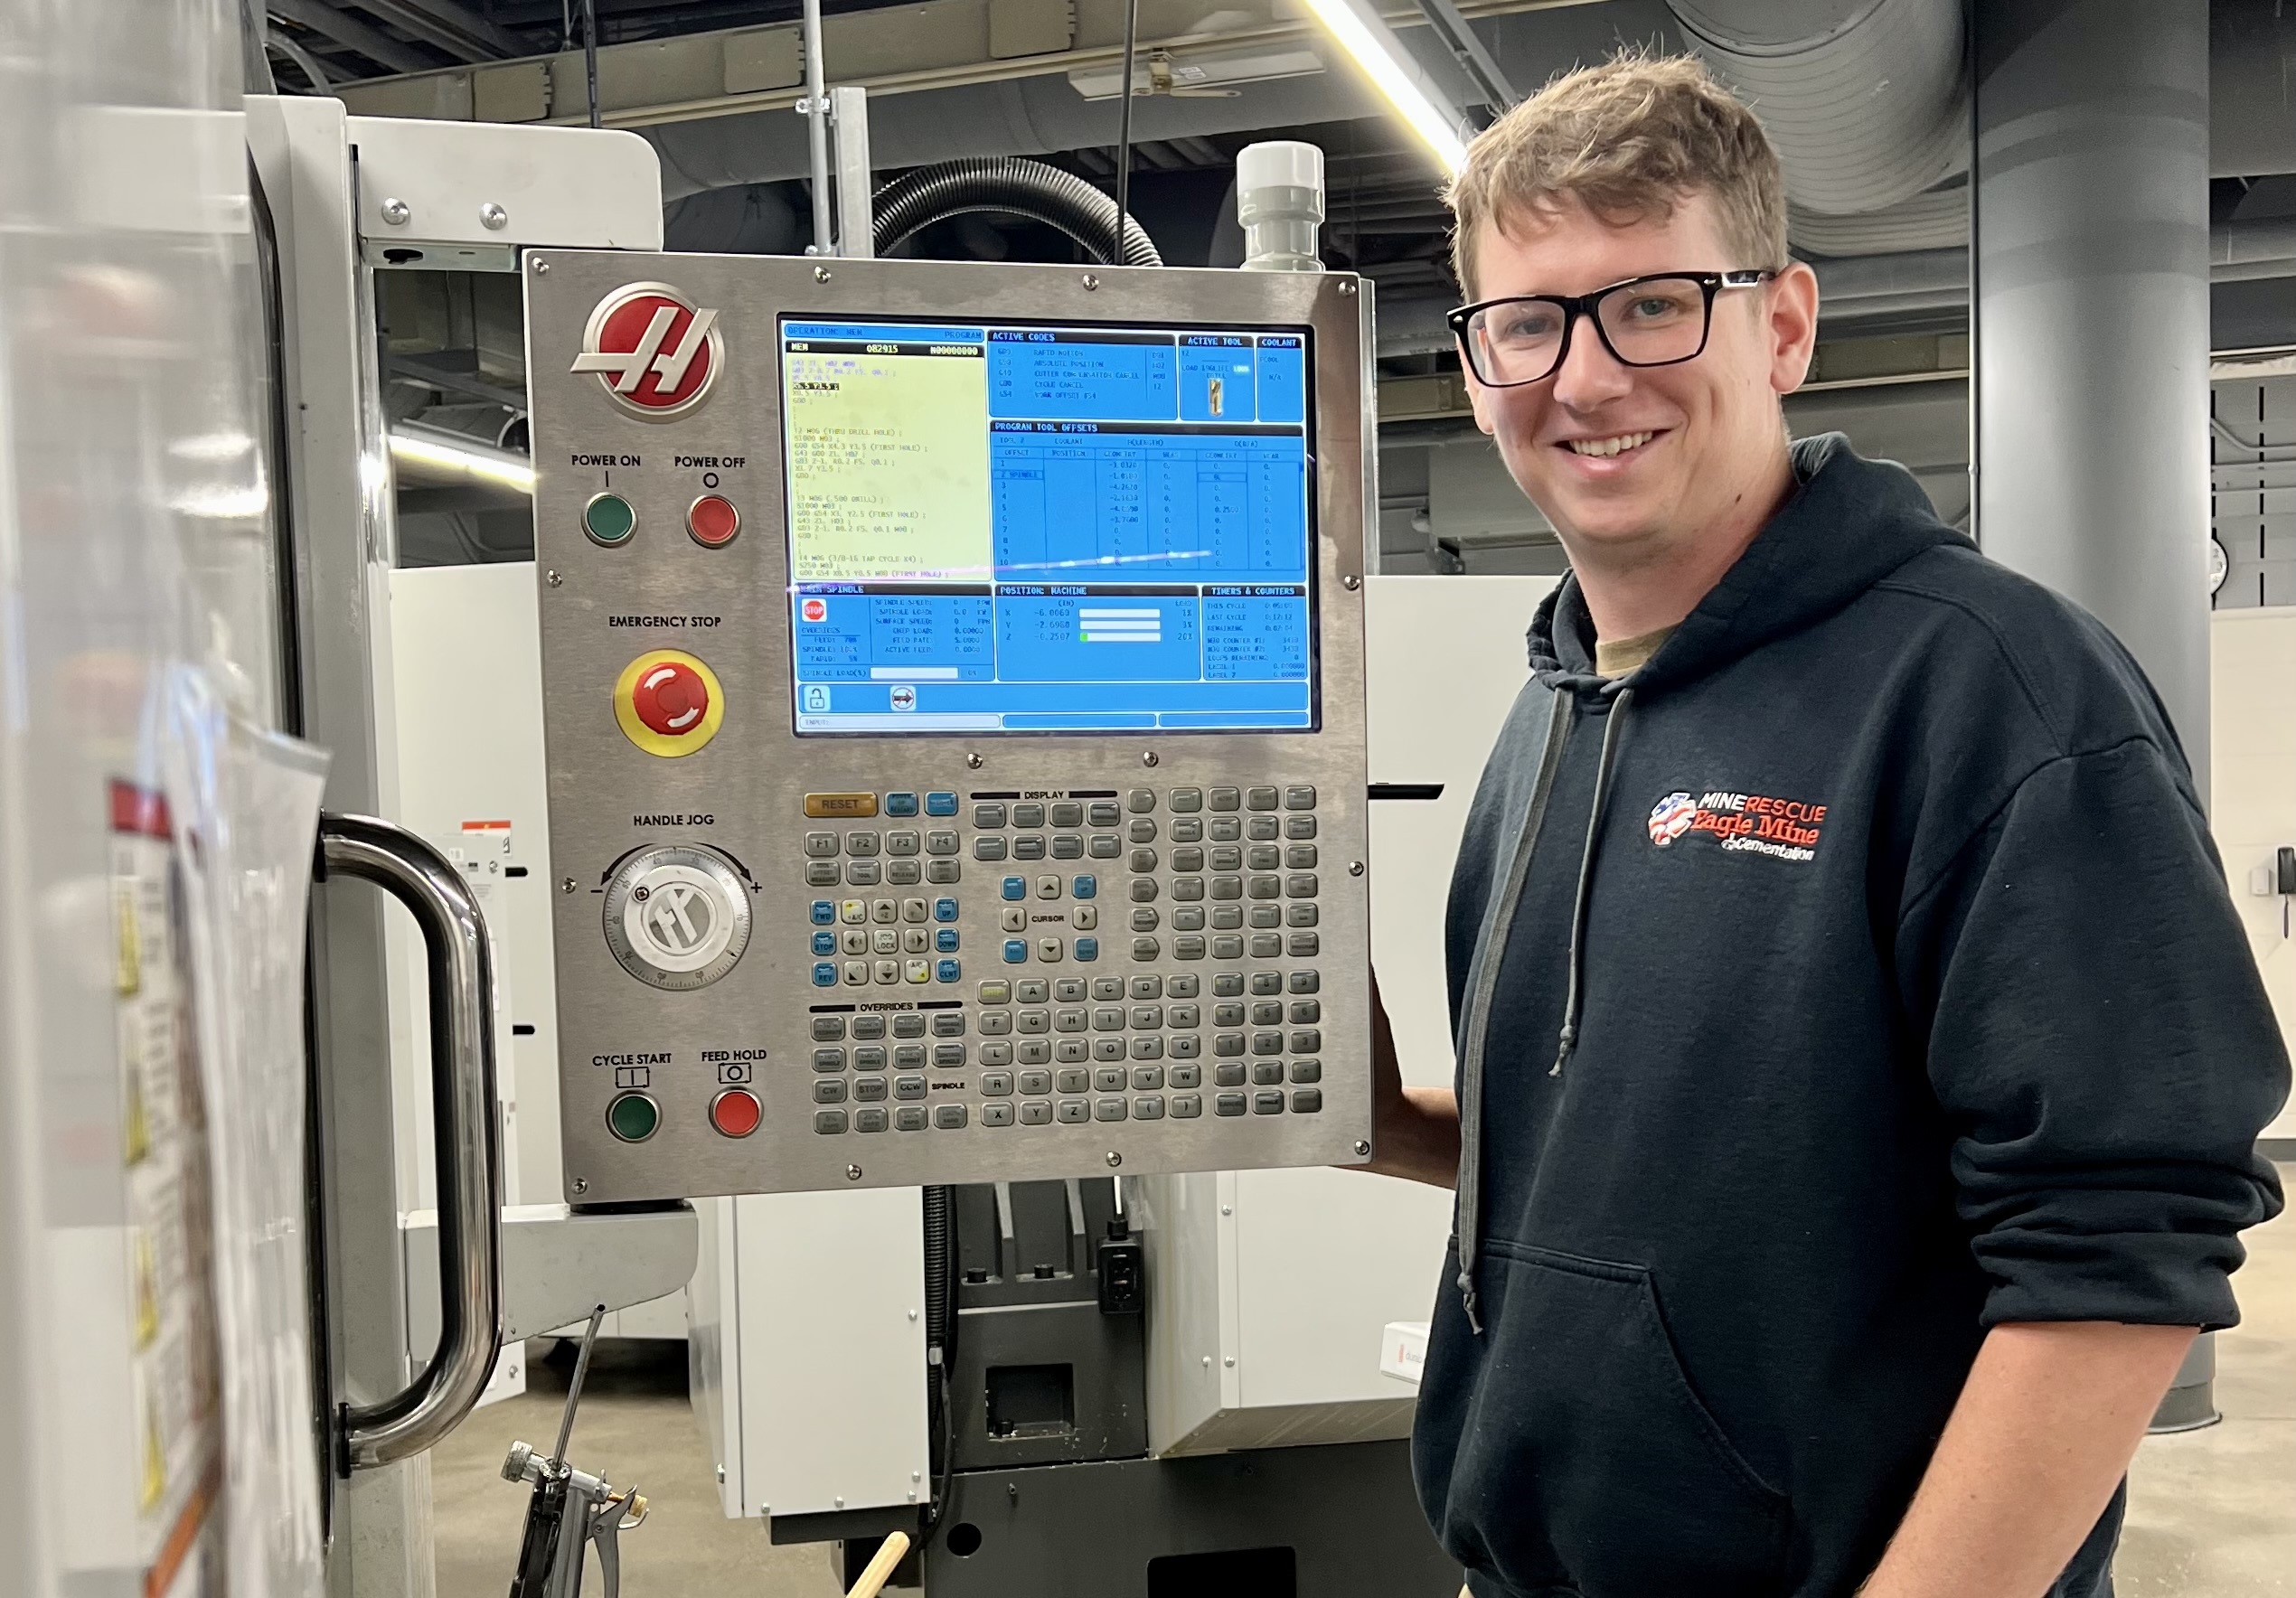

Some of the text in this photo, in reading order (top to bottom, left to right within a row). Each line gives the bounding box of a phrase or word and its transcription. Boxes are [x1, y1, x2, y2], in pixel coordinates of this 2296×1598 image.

[1038, 423, 1057, 431] TOOL
[571, 455, 641, 466] POWER ON
[674, 456, 746, 468] POWER OFF
[608, 616, 720, 627] EMERGENCY STOP
[822, 800, 859, 809] RESET
[634, 814, 714, 826] HANDLE JOG
[1690, 810, 1819, 844] Eagle Mine
[816, 840, 828, 849] F1
[857, 839, 870, 848] F2
[897, 838, 909, 846] F3
[936, 837, 948, 846] F4
[1068, 985, 1075, 994] B
[1105, 984, 1113, 992] C
[1142, 983, 1150, 992] D
[1180, 982, 1187, 990] E
[1029, 987, 1037, 995] A
[861, 1002, 913, 1011] OVERRIDES
[1144, 1013, 1150, 1021] J
[1265, 1009, 1270, 1017] 5
[993, 1019, 998, 1027] F
[1030, 1017, 1038, 1026] G
[1068, 1017, 1076, 1025] H
[1106, 1045, 1115, 1053] O
[1144, 1043, 1151, 1051] P
[1181, 1042, 1189, 1050] Q
[993, 1049, 1000, 1058] L
[1030, 1048, 1039, 1056] M
[1069, 1047, 1077, 1055] N
[701, 1049, 767, 1062] FEED HOLD
[592, 1053, 672, 1067] CYCLE START
[1181, 1072, 1190, 1080] W
[1266, 1068, 1272, 1076] 0
[1031, 1078, 1039, 1086] S
[1070, 1076, 1077, 1085] T
[1108, 1075, 1115, 1083] U
[1145, 1074, 1152, 1082] V
[932, 1082, 965, 1090] SPINDLE
[993, 1080, 1001, 1088] R
[994, 1110, 1002, 1118] X
[1033, 1108, 1040, 1116] Y
[1070, 1107, 1077, 1115] Z
